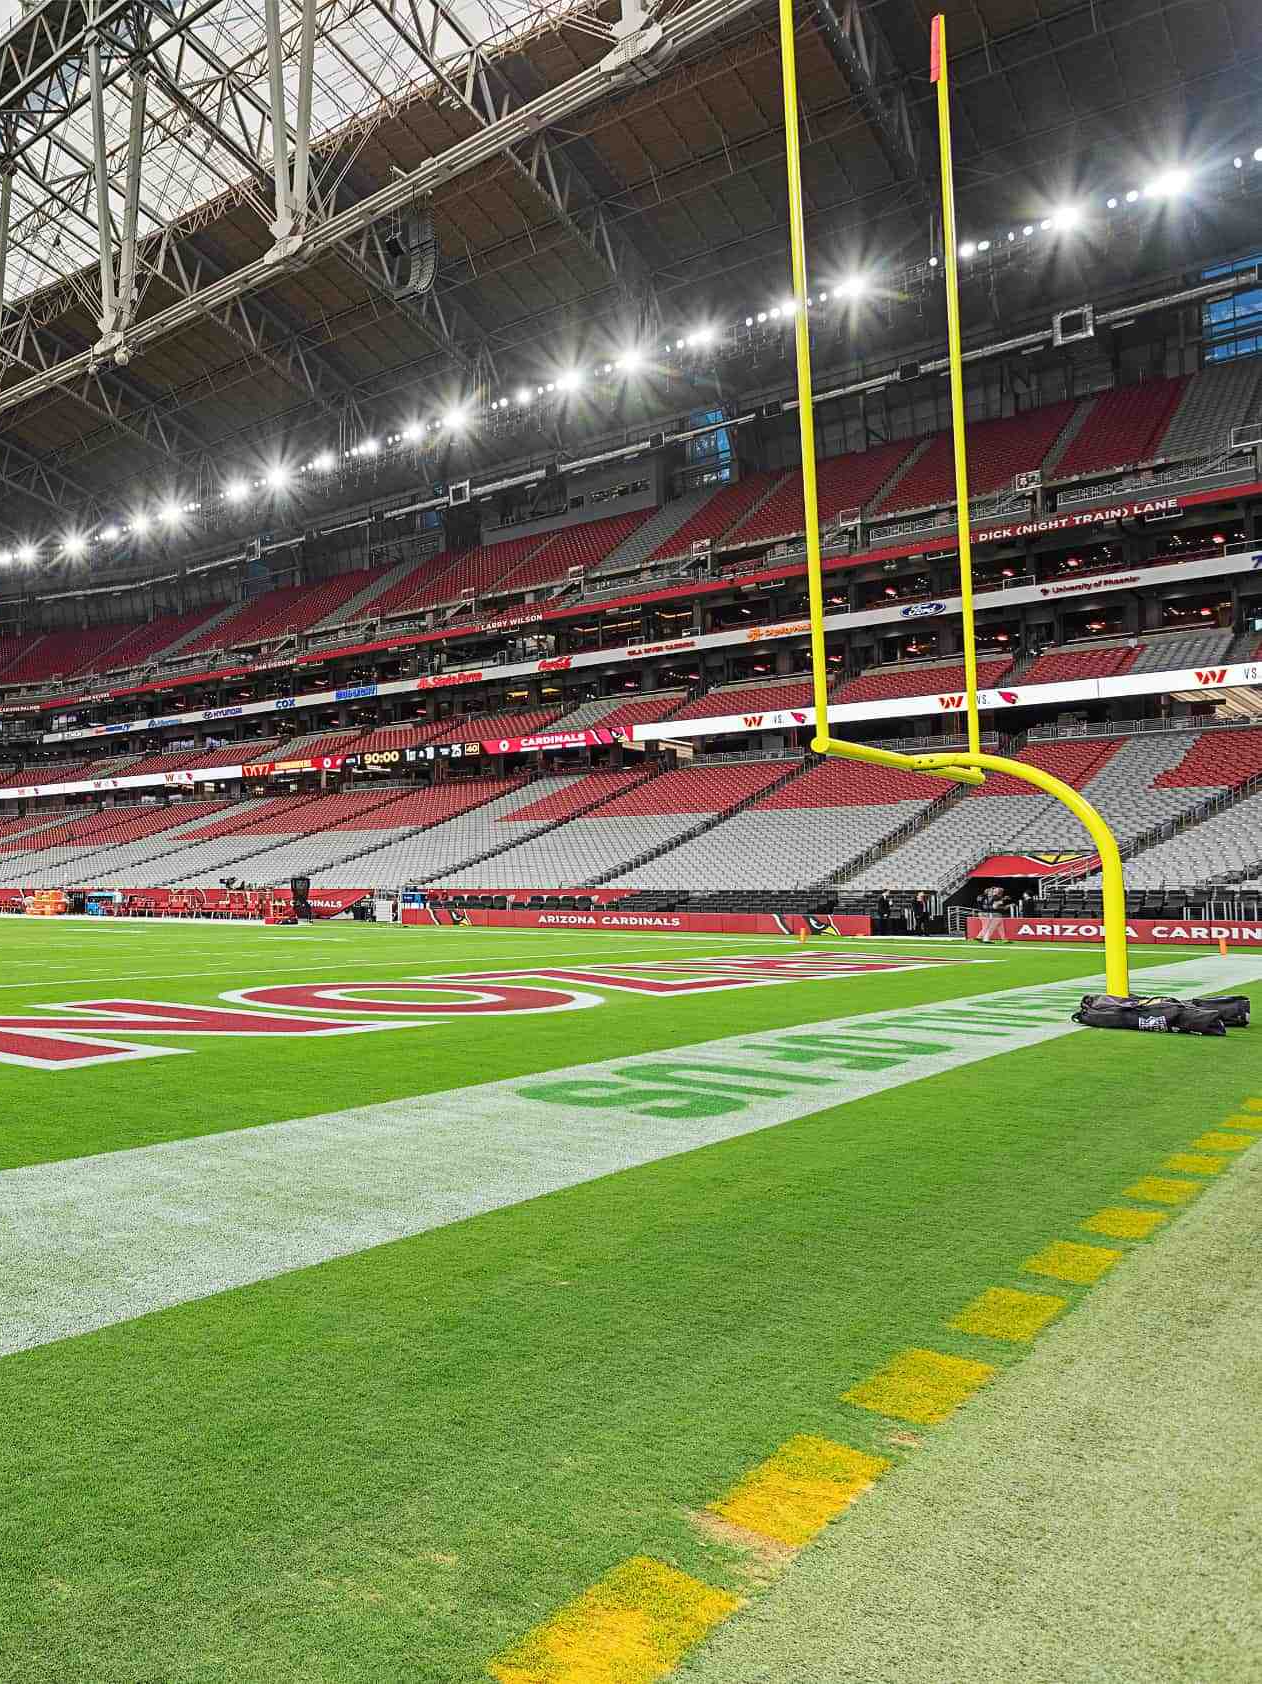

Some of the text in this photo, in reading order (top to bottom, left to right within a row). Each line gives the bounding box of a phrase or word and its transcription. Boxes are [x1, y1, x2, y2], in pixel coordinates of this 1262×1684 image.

[978, 530, 1012, 542] DICK
[1016, 518, 1068, 536] (NIGHT
[1073, 508, 1129, 525] TRAIN)
[1134, 499, 1178, 514] LANE
[481, 614, 543, 631] LARRY WILSON
[276, 698, 295, 709] COX
[521, 733, 586, 746] CARDINALS
[451, 744, 461, 757] 25
[466, 743, 477, 753] 40
[364, 751, 399, 764] 90:00
[538, 915, 681, 926] ARIZONA CARDINALS
[1017, 924, 1138, 938] ARIZOA
[738, 1034, 955, 1072] OF
[517, 1062, 839, 1120] US
